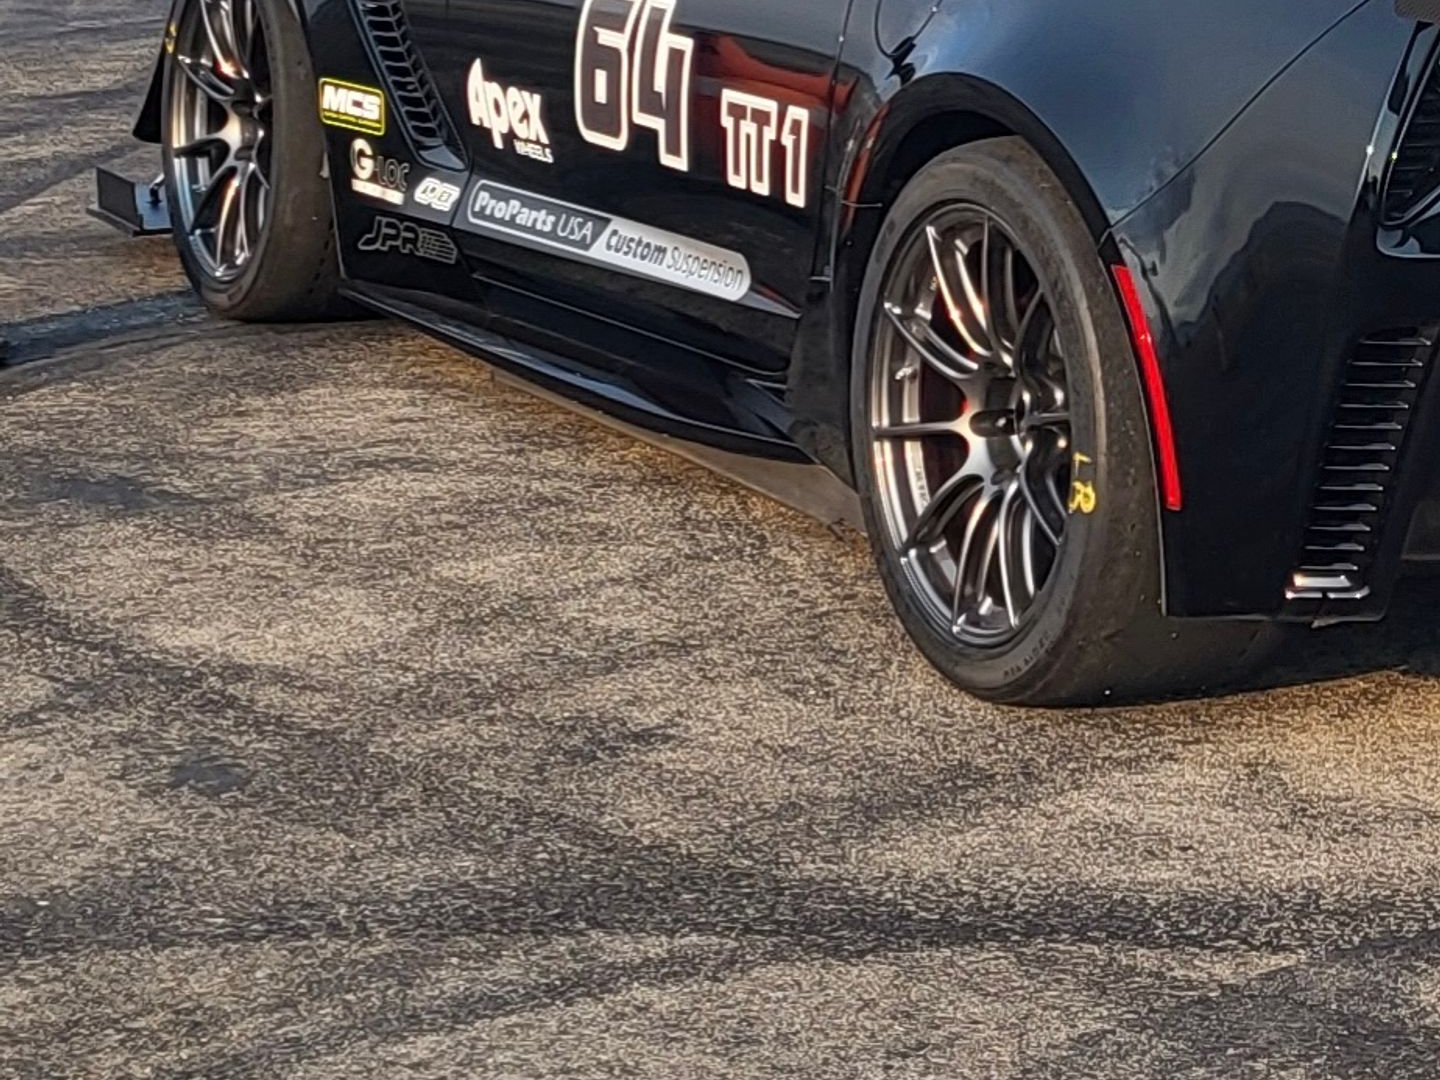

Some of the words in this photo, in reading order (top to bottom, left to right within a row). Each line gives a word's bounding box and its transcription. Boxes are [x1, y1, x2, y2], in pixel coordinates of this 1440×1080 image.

[322, 84, 381, 121] MCS
[467, 57, 550, 150] Apex
[474, 190, 555, 233] ProParts
[556, 213, 594, 245] USA
[605, 228, 668, 266] Custom
[666, 245, 744, 292] Suspension
